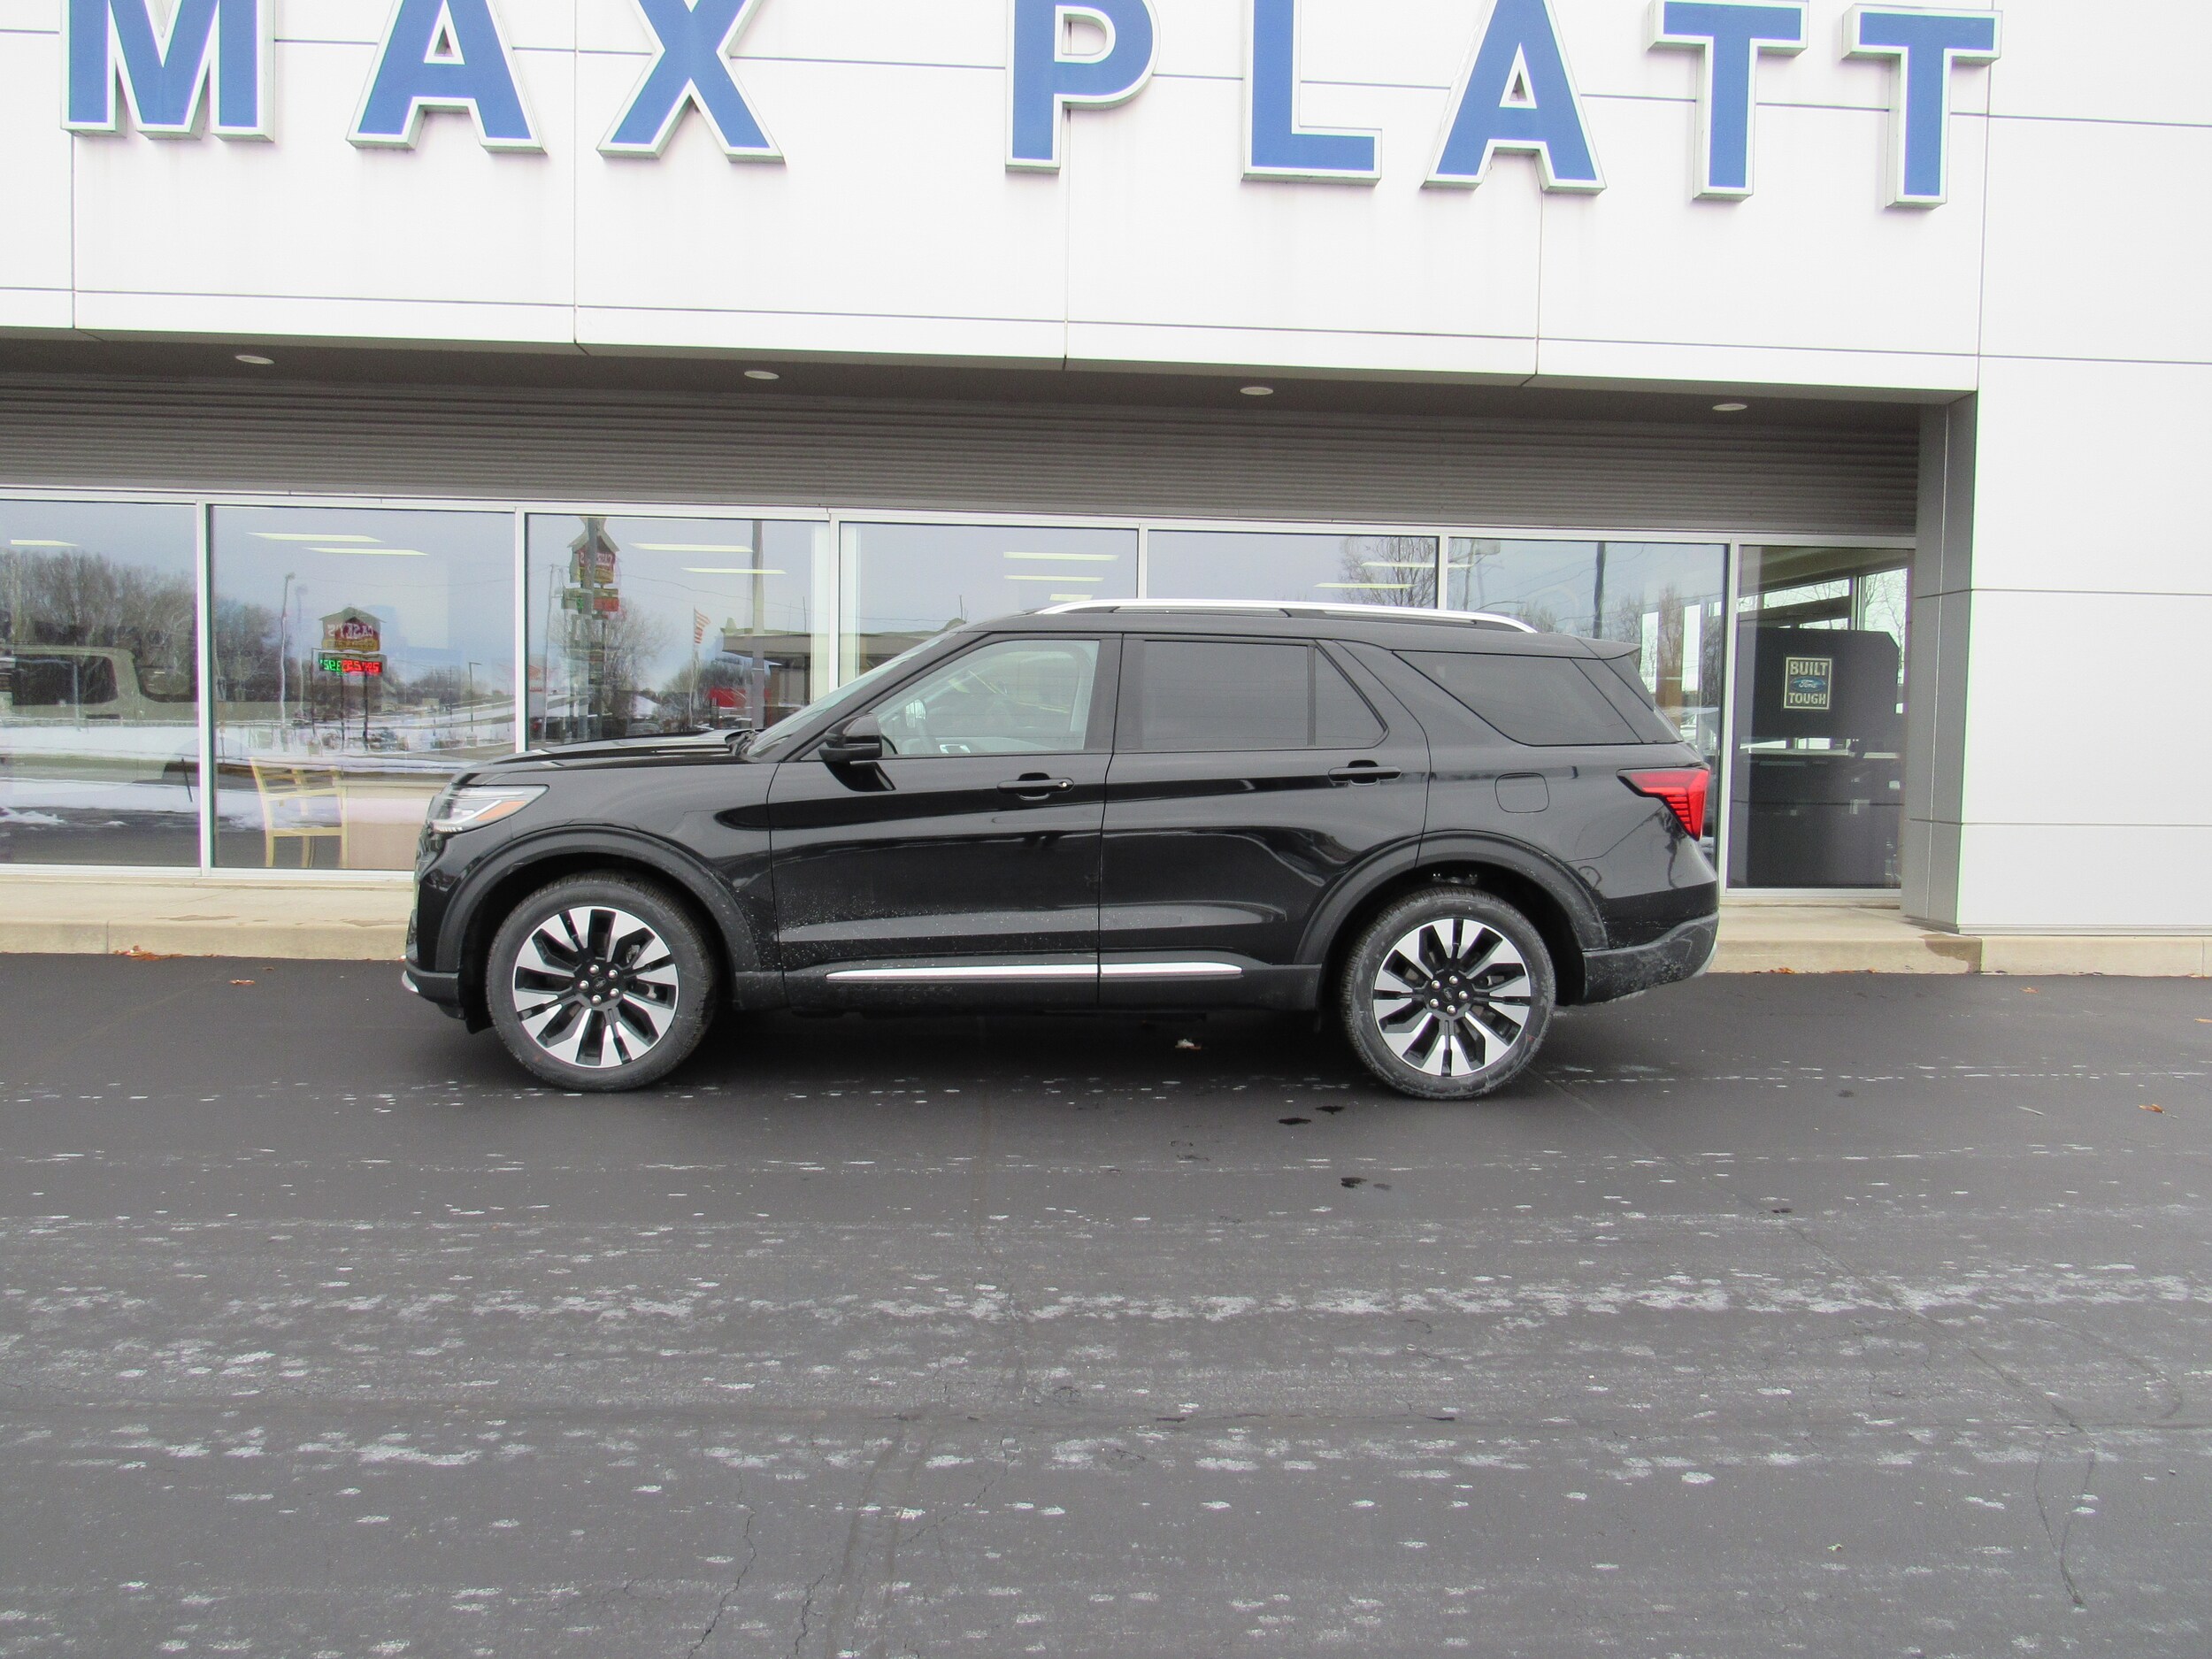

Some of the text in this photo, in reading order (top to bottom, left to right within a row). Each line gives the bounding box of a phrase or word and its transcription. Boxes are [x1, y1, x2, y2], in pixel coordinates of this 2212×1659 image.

[60, 0, 2002, 209] MAX PLATT
[1789, 661, 1828, 676] BUILT
[1798, 679, 1817, 688] Ford
[1788, 693, 1826, 705] TOUGH
